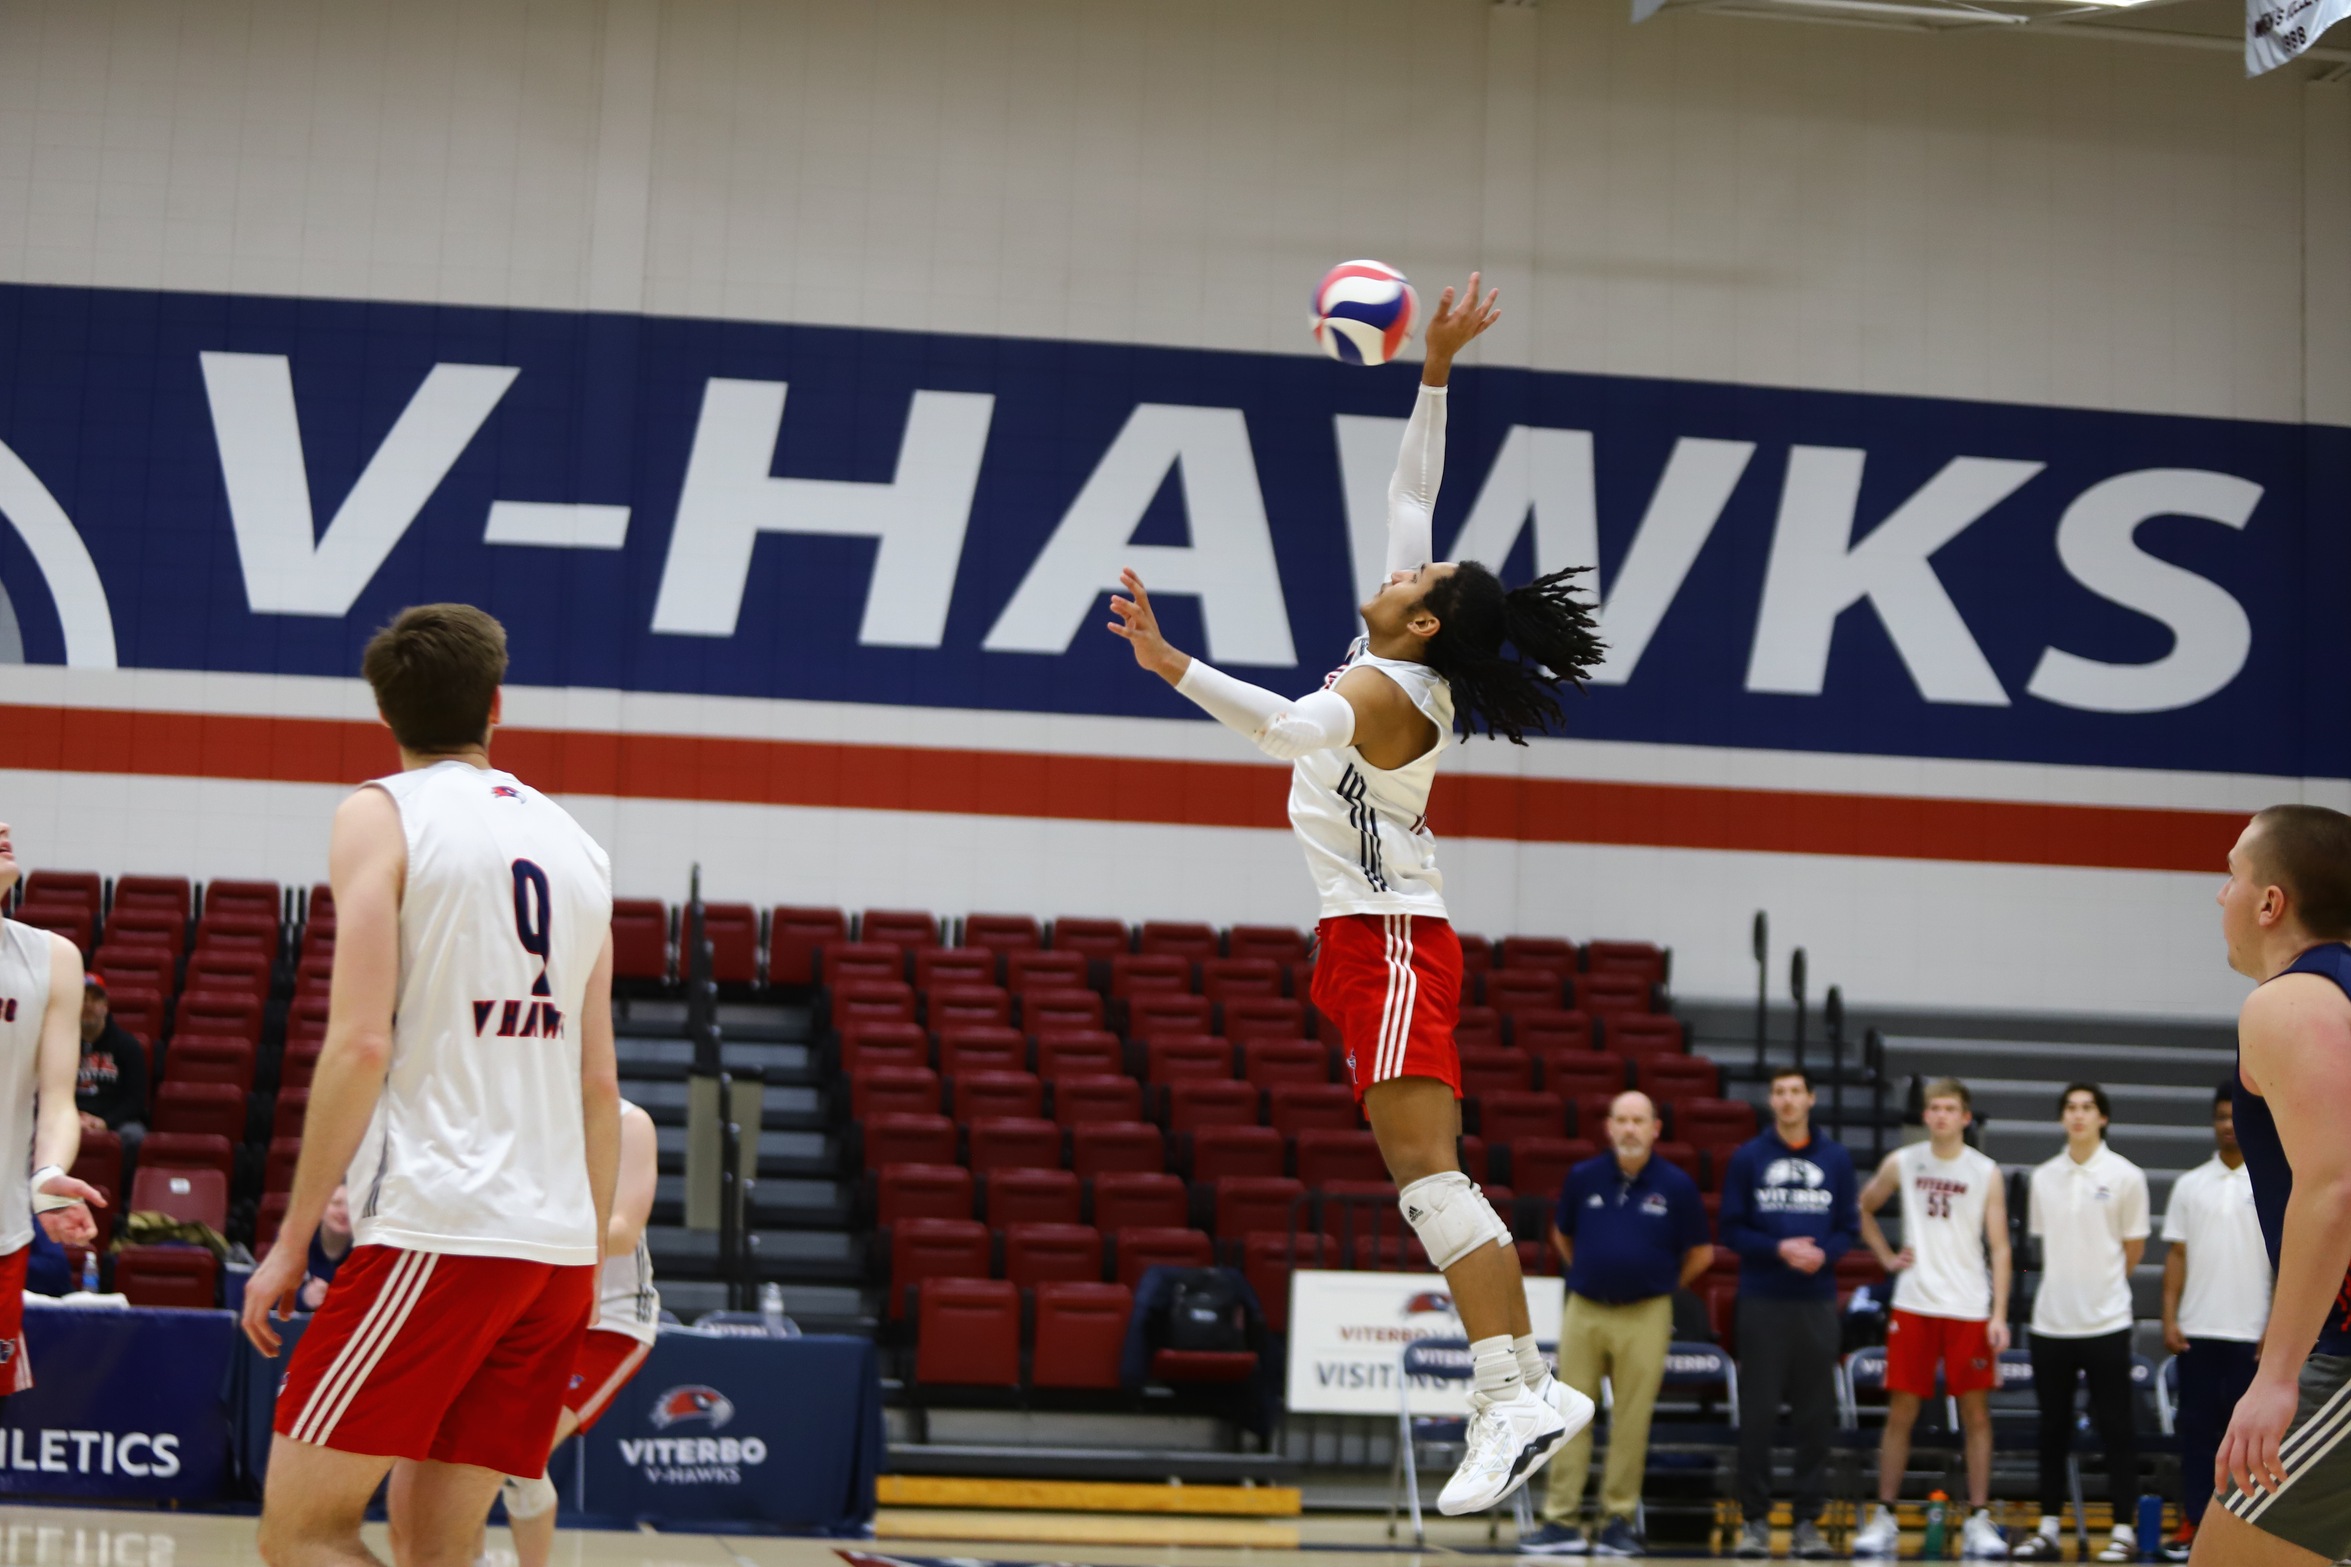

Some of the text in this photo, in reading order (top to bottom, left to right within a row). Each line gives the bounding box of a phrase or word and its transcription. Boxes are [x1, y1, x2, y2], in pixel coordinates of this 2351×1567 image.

[200, 351, 2265, 713] V-HAWKS
[1928, 1191, 1951, 1219] 55
[0, 1427, 182, 1478] LETICS
[618, 1436, 768, 1466] VITERBO
[644, 1466, 741, 1485] V-HAWKS
